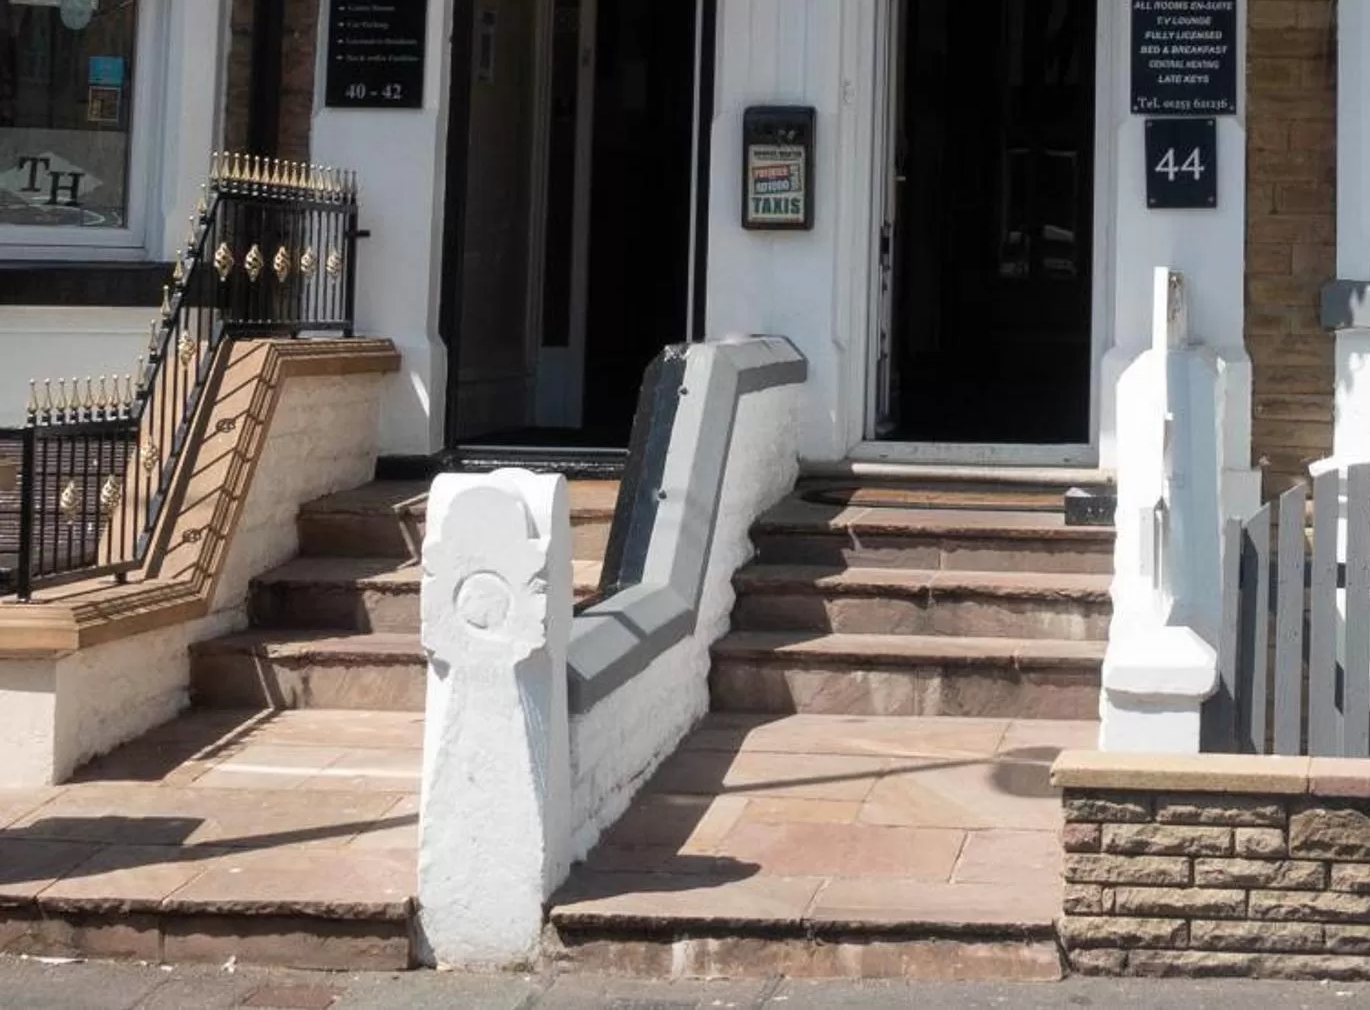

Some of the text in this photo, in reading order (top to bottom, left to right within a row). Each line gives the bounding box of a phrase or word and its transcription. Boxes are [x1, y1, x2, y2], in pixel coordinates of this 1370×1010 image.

[1134, 1, 1152, 11] ALL
[1154, 147, 1205, 181] 44
[752, 197, 801, 215] TAXIS
